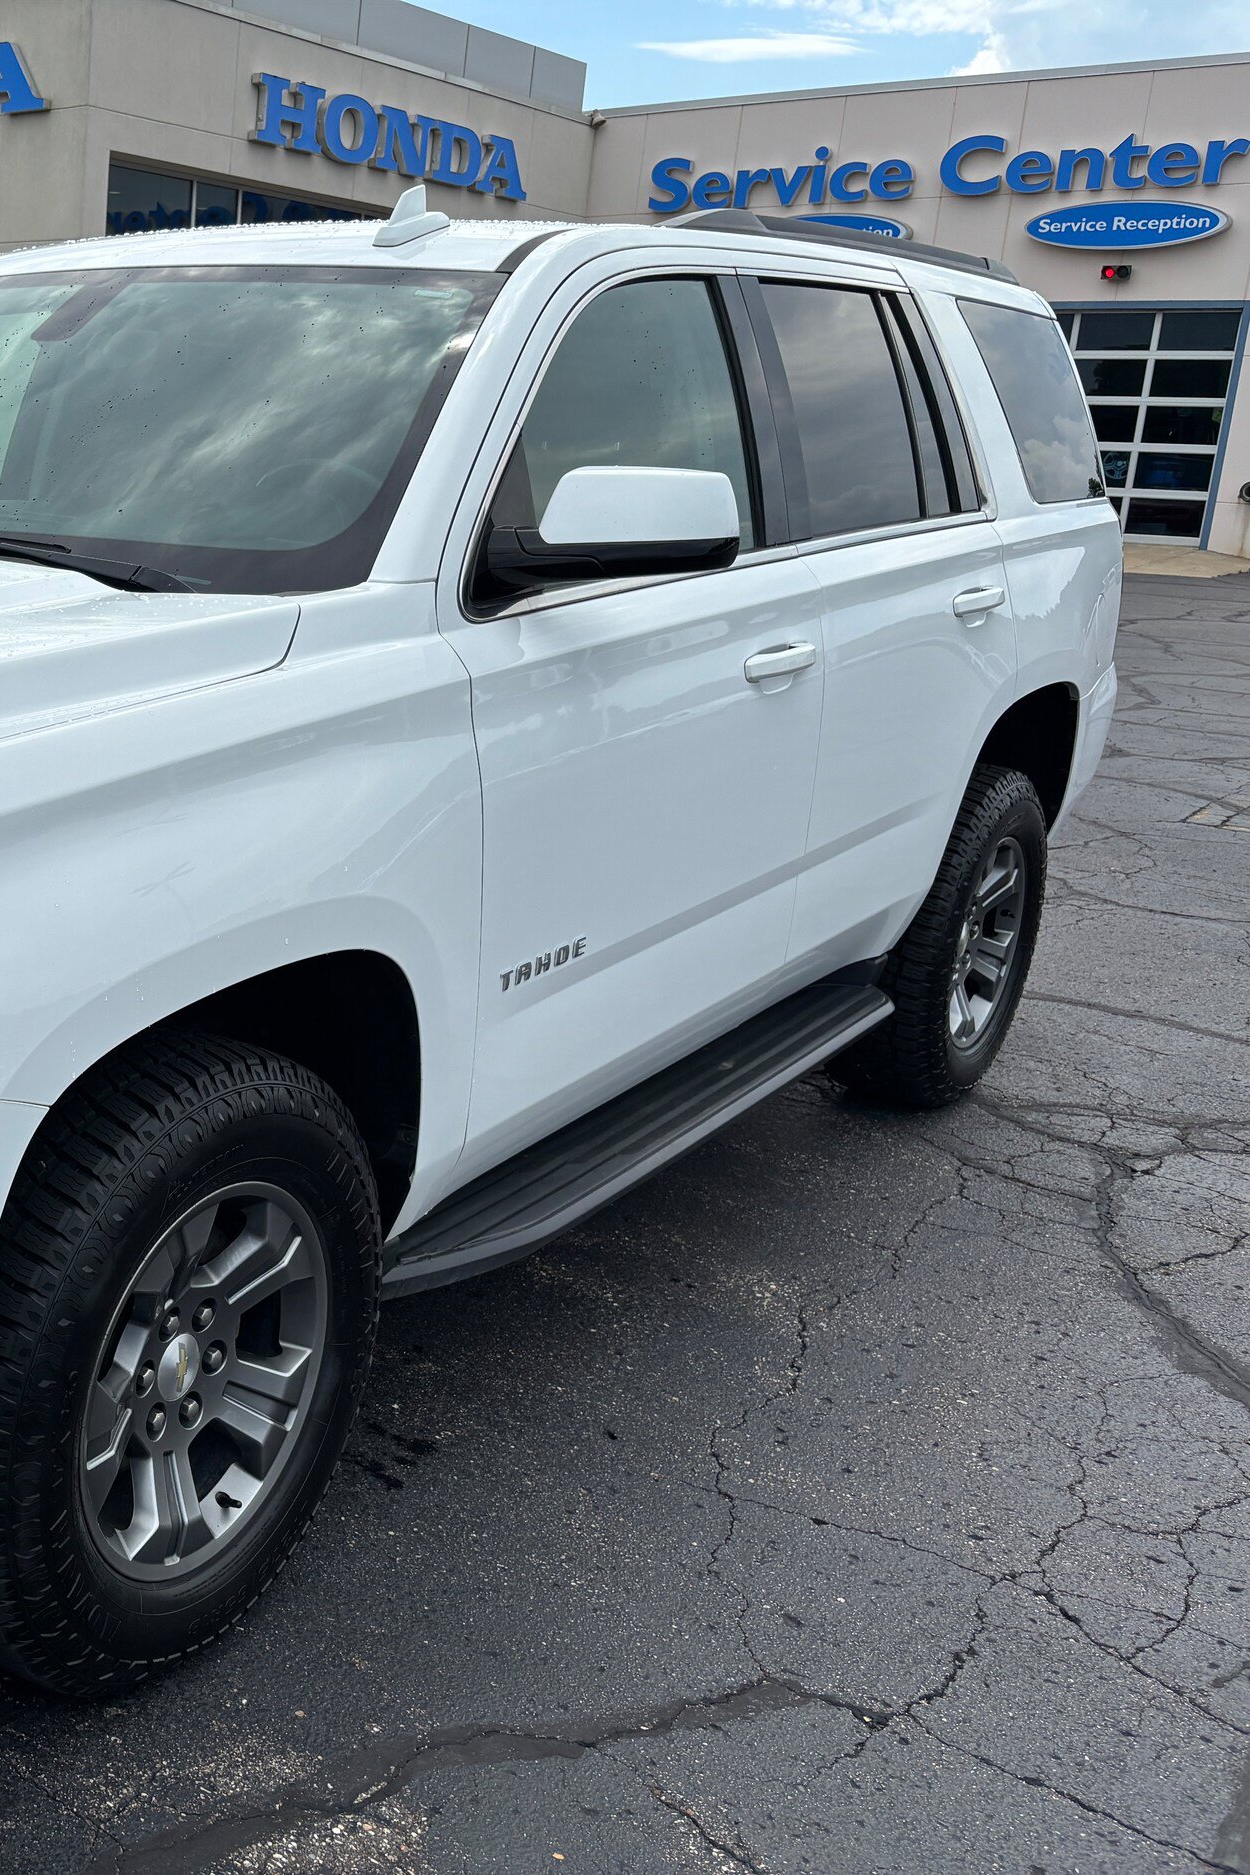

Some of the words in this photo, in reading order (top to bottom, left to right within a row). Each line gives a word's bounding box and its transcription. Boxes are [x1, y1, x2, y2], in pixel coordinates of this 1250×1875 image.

[248, 72, 526, 200] HONDA
[648, 146, 915, 213] Service
[940, 133, 1250, 196] Center
[1038, 218, 1107, 233] Service
[1112, 214, 1211, 233] Reception
[500, 935, 587, 992] TAHOE
